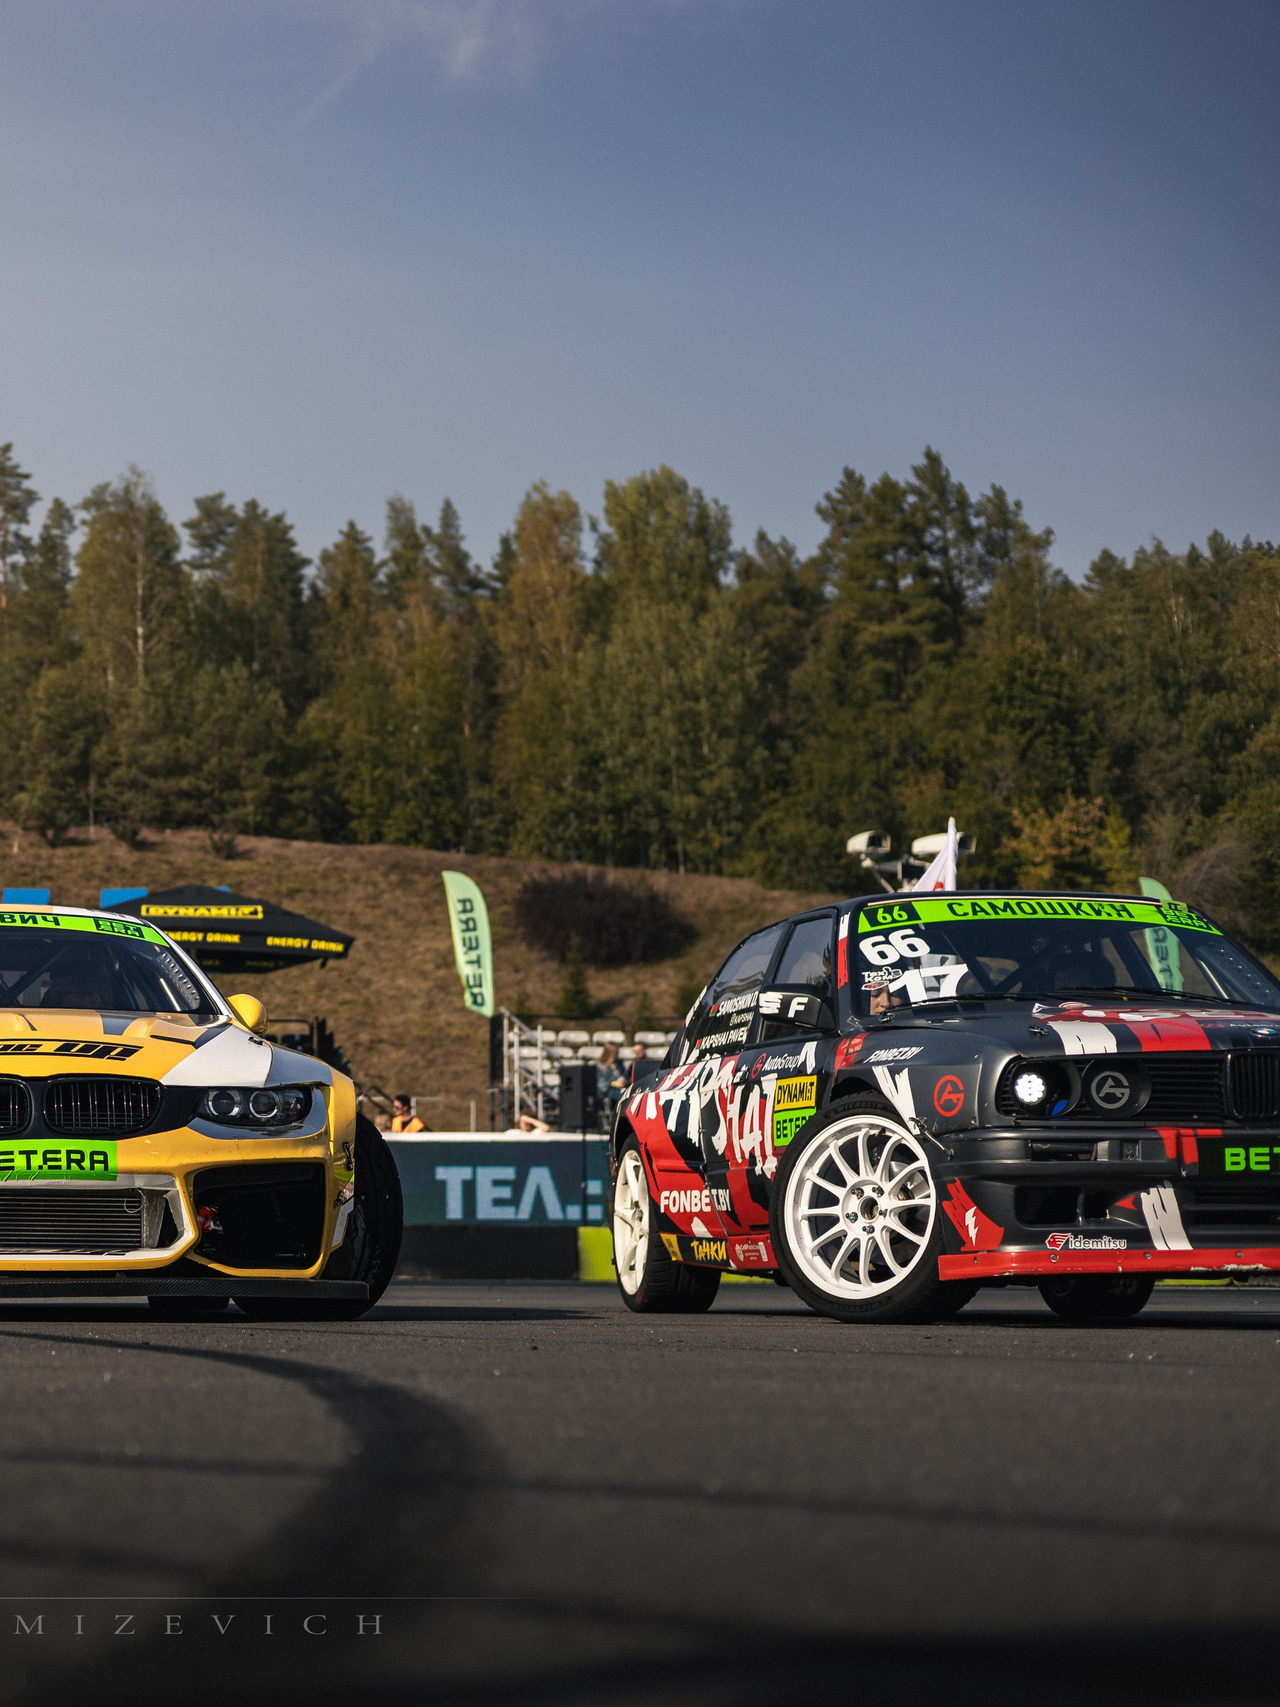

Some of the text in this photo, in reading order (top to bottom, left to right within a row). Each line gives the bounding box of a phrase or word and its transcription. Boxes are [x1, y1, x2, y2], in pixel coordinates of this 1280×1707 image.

[877, 905, 908, 924] 66
[206, 931, 240, 943] DRINK
[266, 936, 345, 952] ENERGY DRINK
[859, 928, 931, 966] 66
[888, 963, 969, 1004] 17
[1069, 1234, 1128, 1250] idemitsu
